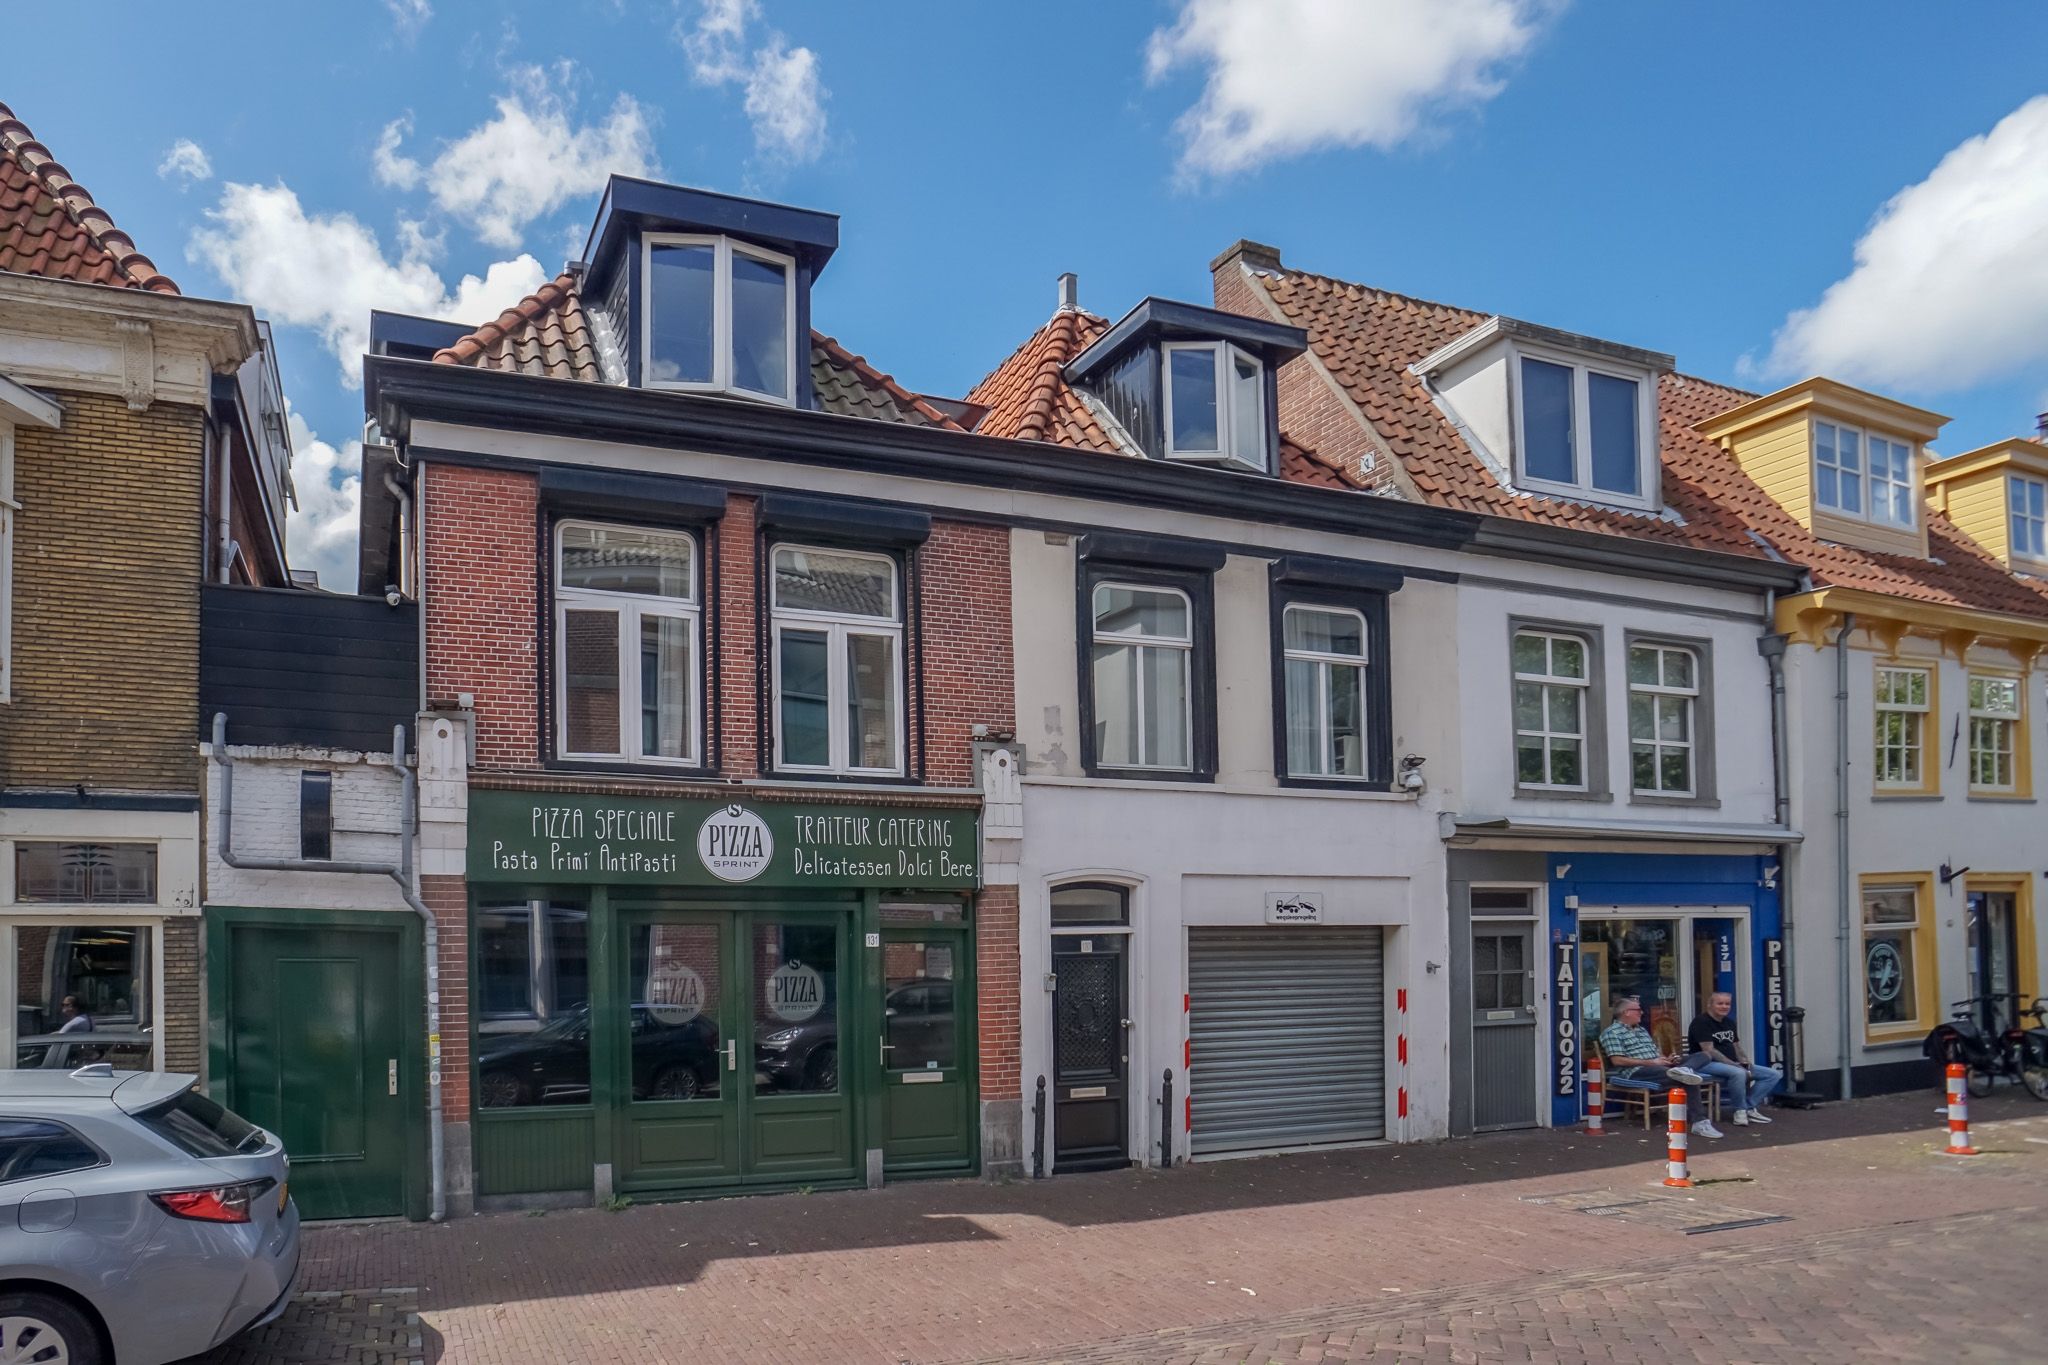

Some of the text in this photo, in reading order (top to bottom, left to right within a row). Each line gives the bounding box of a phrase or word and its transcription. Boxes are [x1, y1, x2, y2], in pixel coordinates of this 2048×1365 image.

[708, 825, 764, 858] PIZZA
[493, 841, 538, 870] Pasta
[713, 860, 760, 868] SPRINT
[794, 847, 973, 877] Delicatessen Dolci Bere
[867, 935, 878, 946] 131
[1721, 935, 1730, 960] 137
[774, 976, 818, 1002] PIZZA
